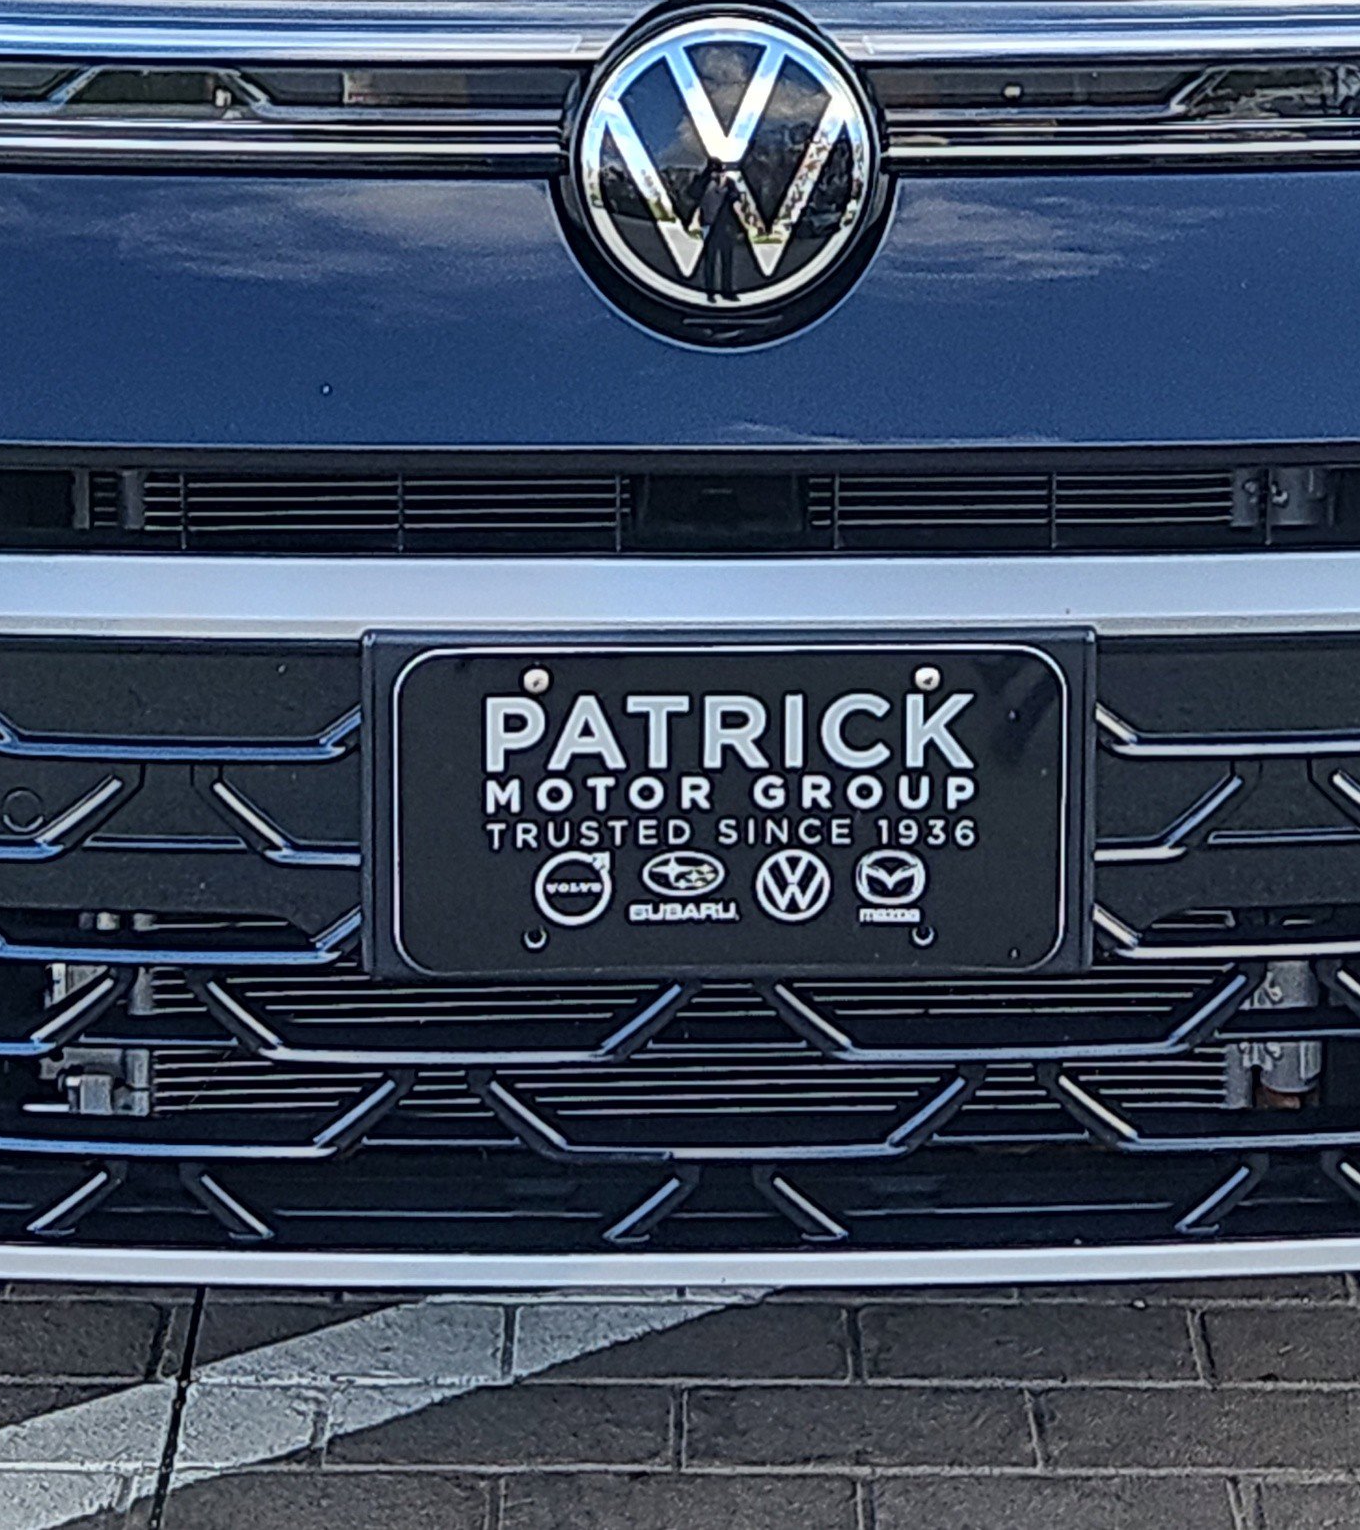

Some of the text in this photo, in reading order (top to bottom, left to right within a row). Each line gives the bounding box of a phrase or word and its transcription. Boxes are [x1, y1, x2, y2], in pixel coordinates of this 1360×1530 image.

[485, 692, 976, 773] PATRICK
[485, 774, 976, 815] MOTOR GROUP
[485, 818, 976, 851] TRUSTED SINCE 1936
[544, 881, 603, 895] VOLVO
[628, 900, 737, 922] SUBARU
